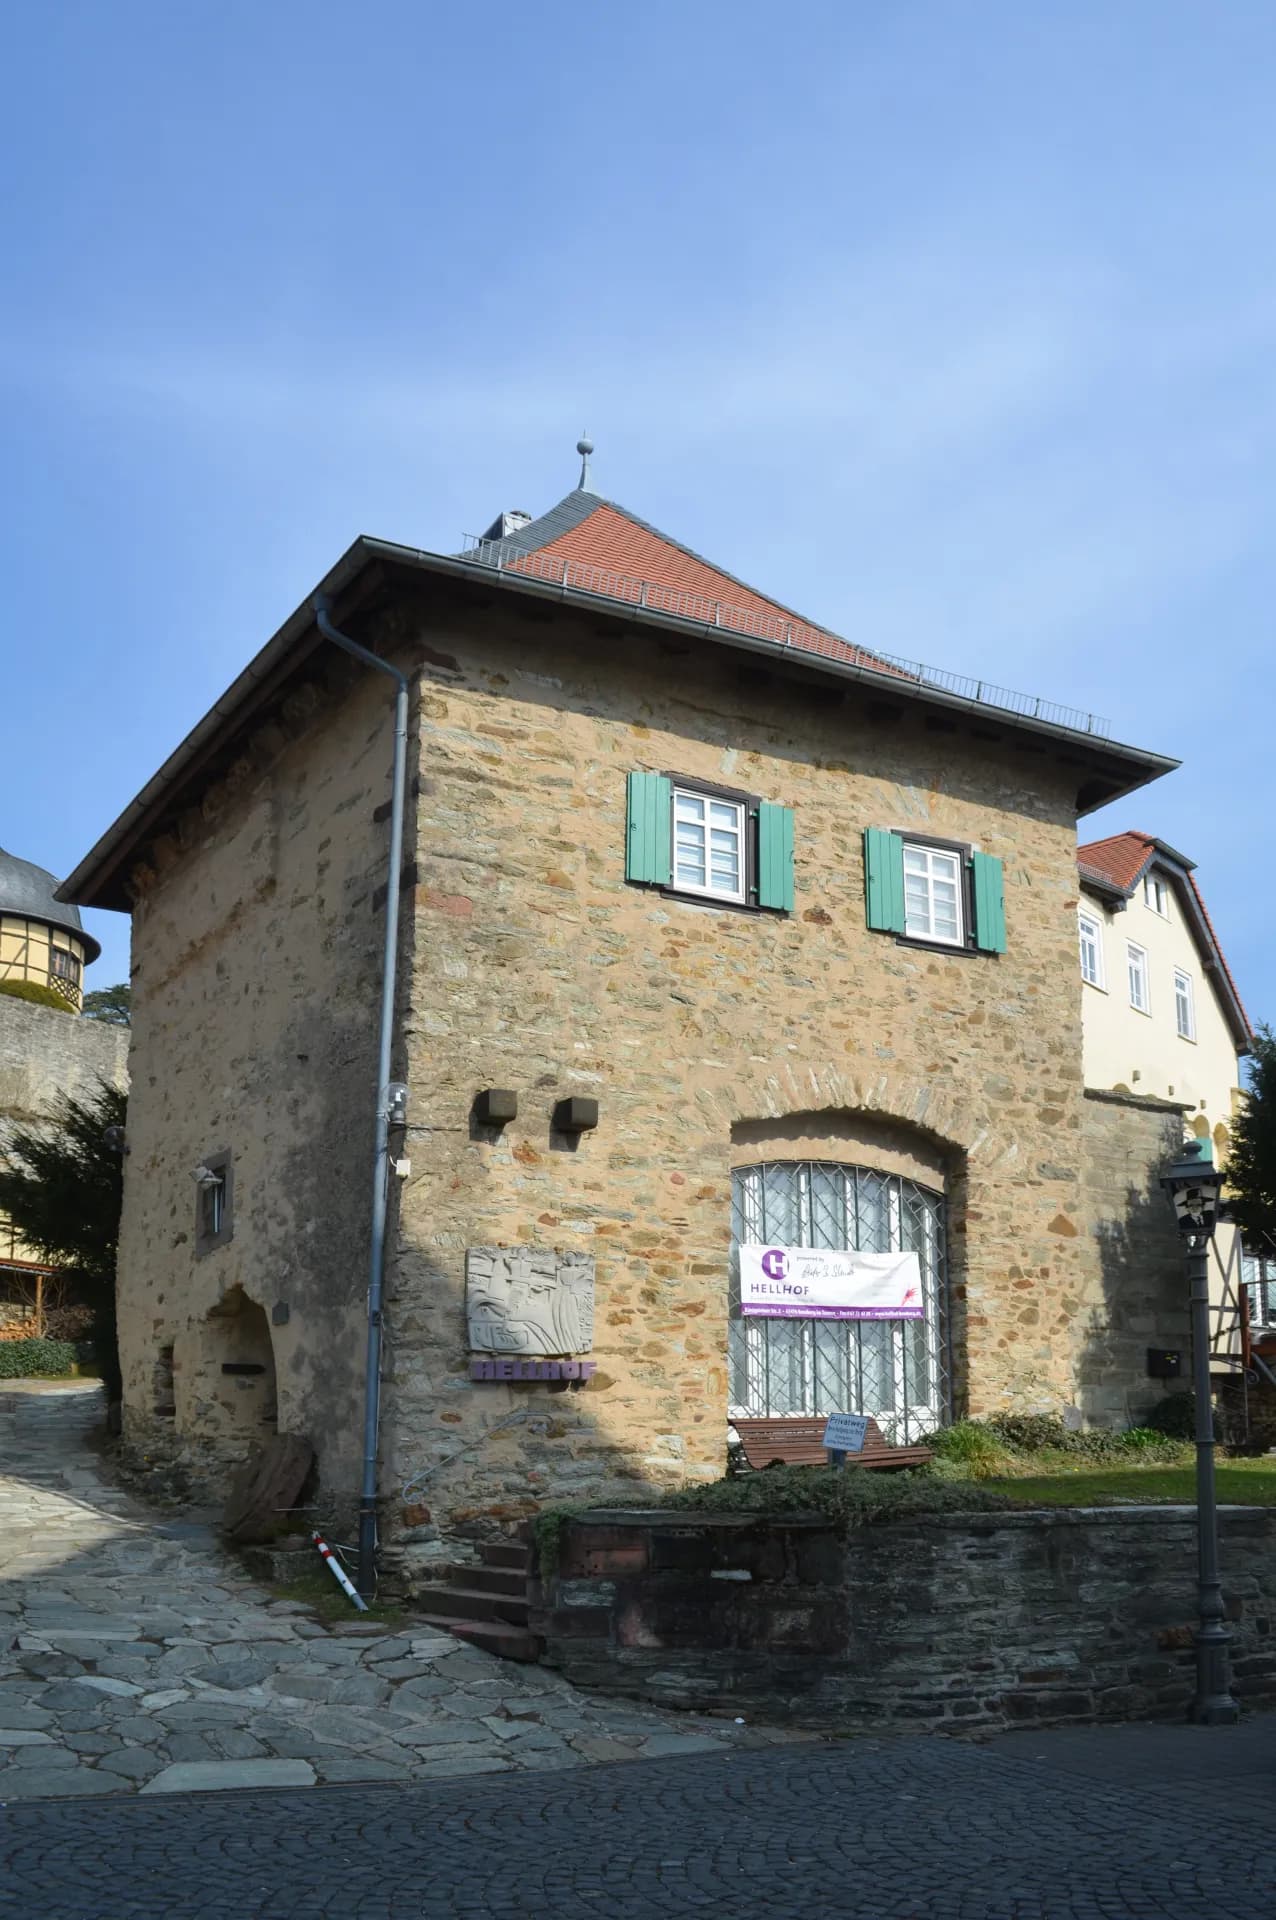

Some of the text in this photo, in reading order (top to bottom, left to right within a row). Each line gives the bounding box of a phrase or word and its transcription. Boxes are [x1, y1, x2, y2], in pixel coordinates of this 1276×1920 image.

[750, 1283, 809, 1296] HELLHOF
[474, 1360, 597, 1380] HELLHOF
[829, 1416, 865, 1429] Privatweg
